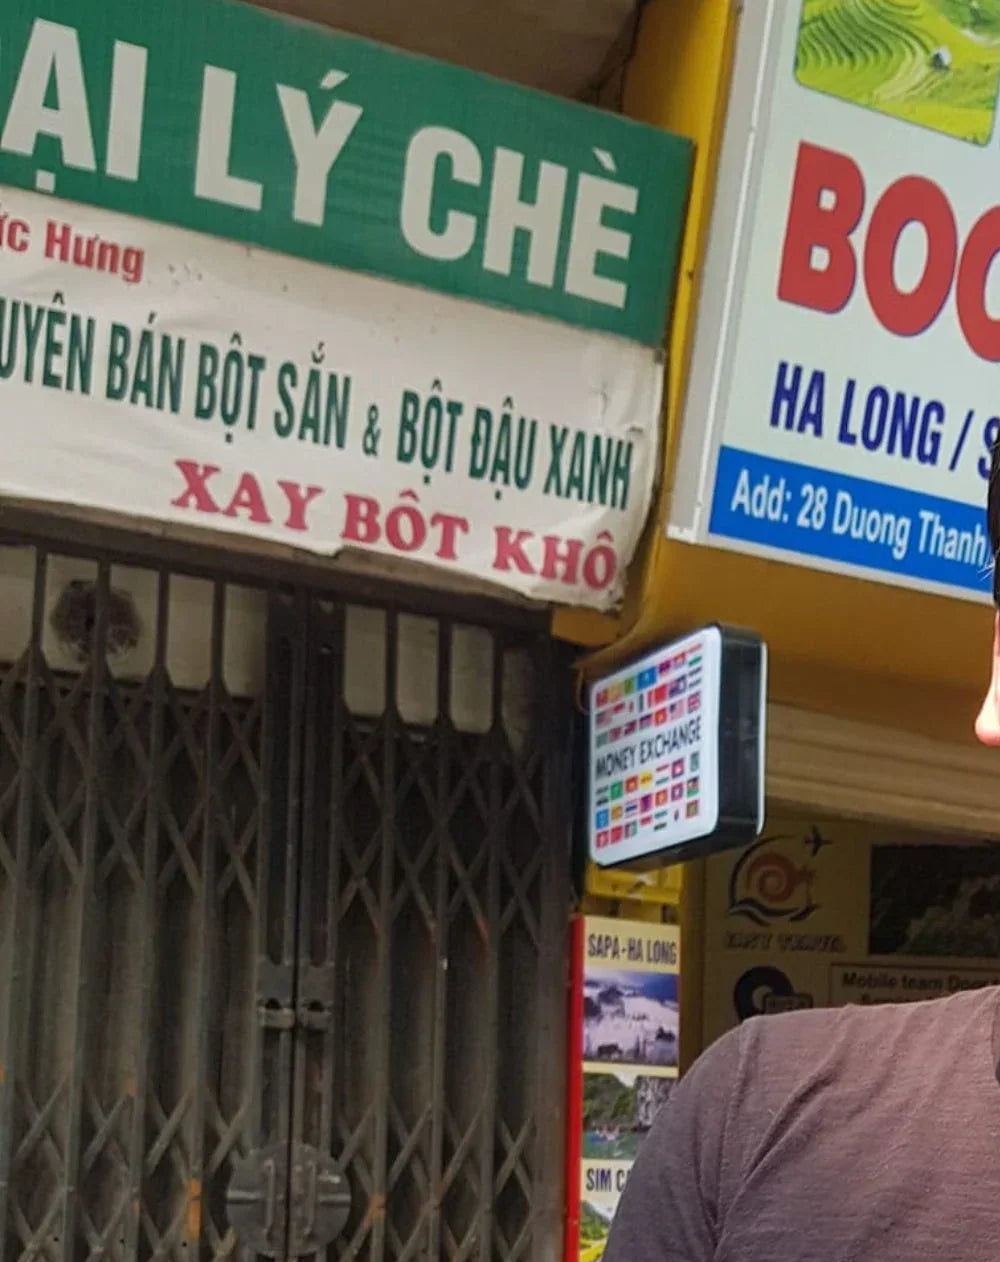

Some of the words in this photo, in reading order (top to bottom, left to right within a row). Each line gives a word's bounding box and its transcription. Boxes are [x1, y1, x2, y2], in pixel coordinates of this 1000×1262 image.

[195, 64, 363, 227] LÝ
[400, 125, 640, 309] CHÈ
[44, 219, 145, 283] Hưng
[106, 311, 186, 414] BÁN
[195, 331, 266, 443] BỘT
[274, 341, 351, 448] SẮN
[362, 404, 381, 456] &
[397, 379, 463, 486] BỘT
[468, 396, 538, 501] ĐẬU
[543, 423, 633, 511] XANH
[769, 361, 826, 438] HA
[837, 378, 946, 466] LONG
[171, 459, 326, 531] XAY
[492, 529, 618, 590] KHÔ
[731, 469, 792, 523] Add:
[797, 483, 828, 531] 28
[832, 490, 911, 561] Duong
[596, 743, 637, 780] MONEY
[639, 716, 702, 765] EXCHANGE
[647, 938, 678, 966] LONG
[586, 1168, 612, 1193] SIM
